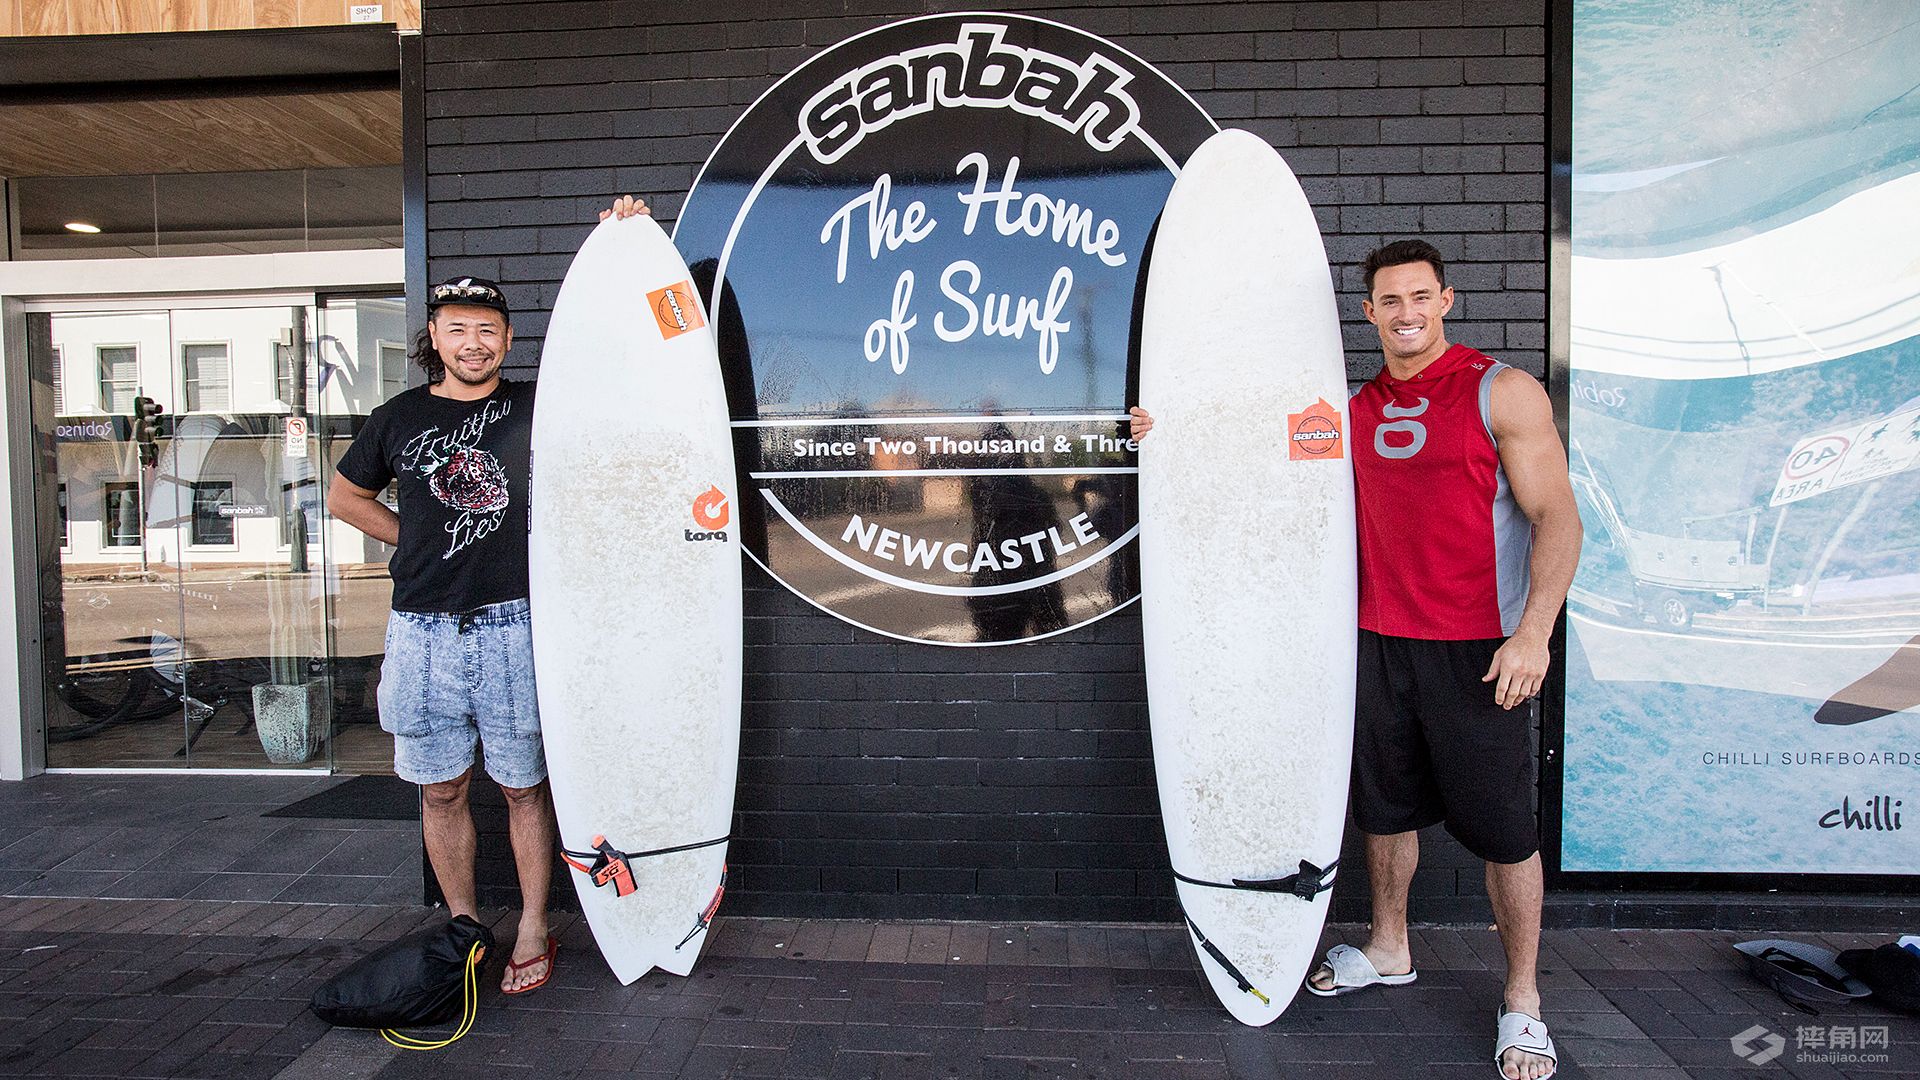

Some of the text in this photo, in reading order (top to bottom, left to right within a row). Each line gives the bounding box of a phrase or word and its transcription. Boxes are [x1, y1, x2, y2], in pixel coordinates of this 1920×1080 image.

[355, 7, 378, 15] SHOP
[798, 23, 1140, 164] sanbah
[820, 152, 1127, 284] The Home
[864, 260, 1072, 374] of Surf
[402, 399, 512, 471] Fruitful
[794, 437, 856, 457] Since
[863, 436, 917, 456] Two
[924, 435, 1045, 456] Thousand
[1054, 434, 1071, 453] &
[1293, 429, 1340, 441] sanbah
[221, 506, 254, 514] sanbah
[443, 509, 507, 560] Lies
[684, 529, 728, 542] torq
[841, 511, 1100, 573] NEWCASTLE
[1702, 752, 1920, 765] CHILLI SURFBOARDS
[1818, 795, 1902, 831] chilli
